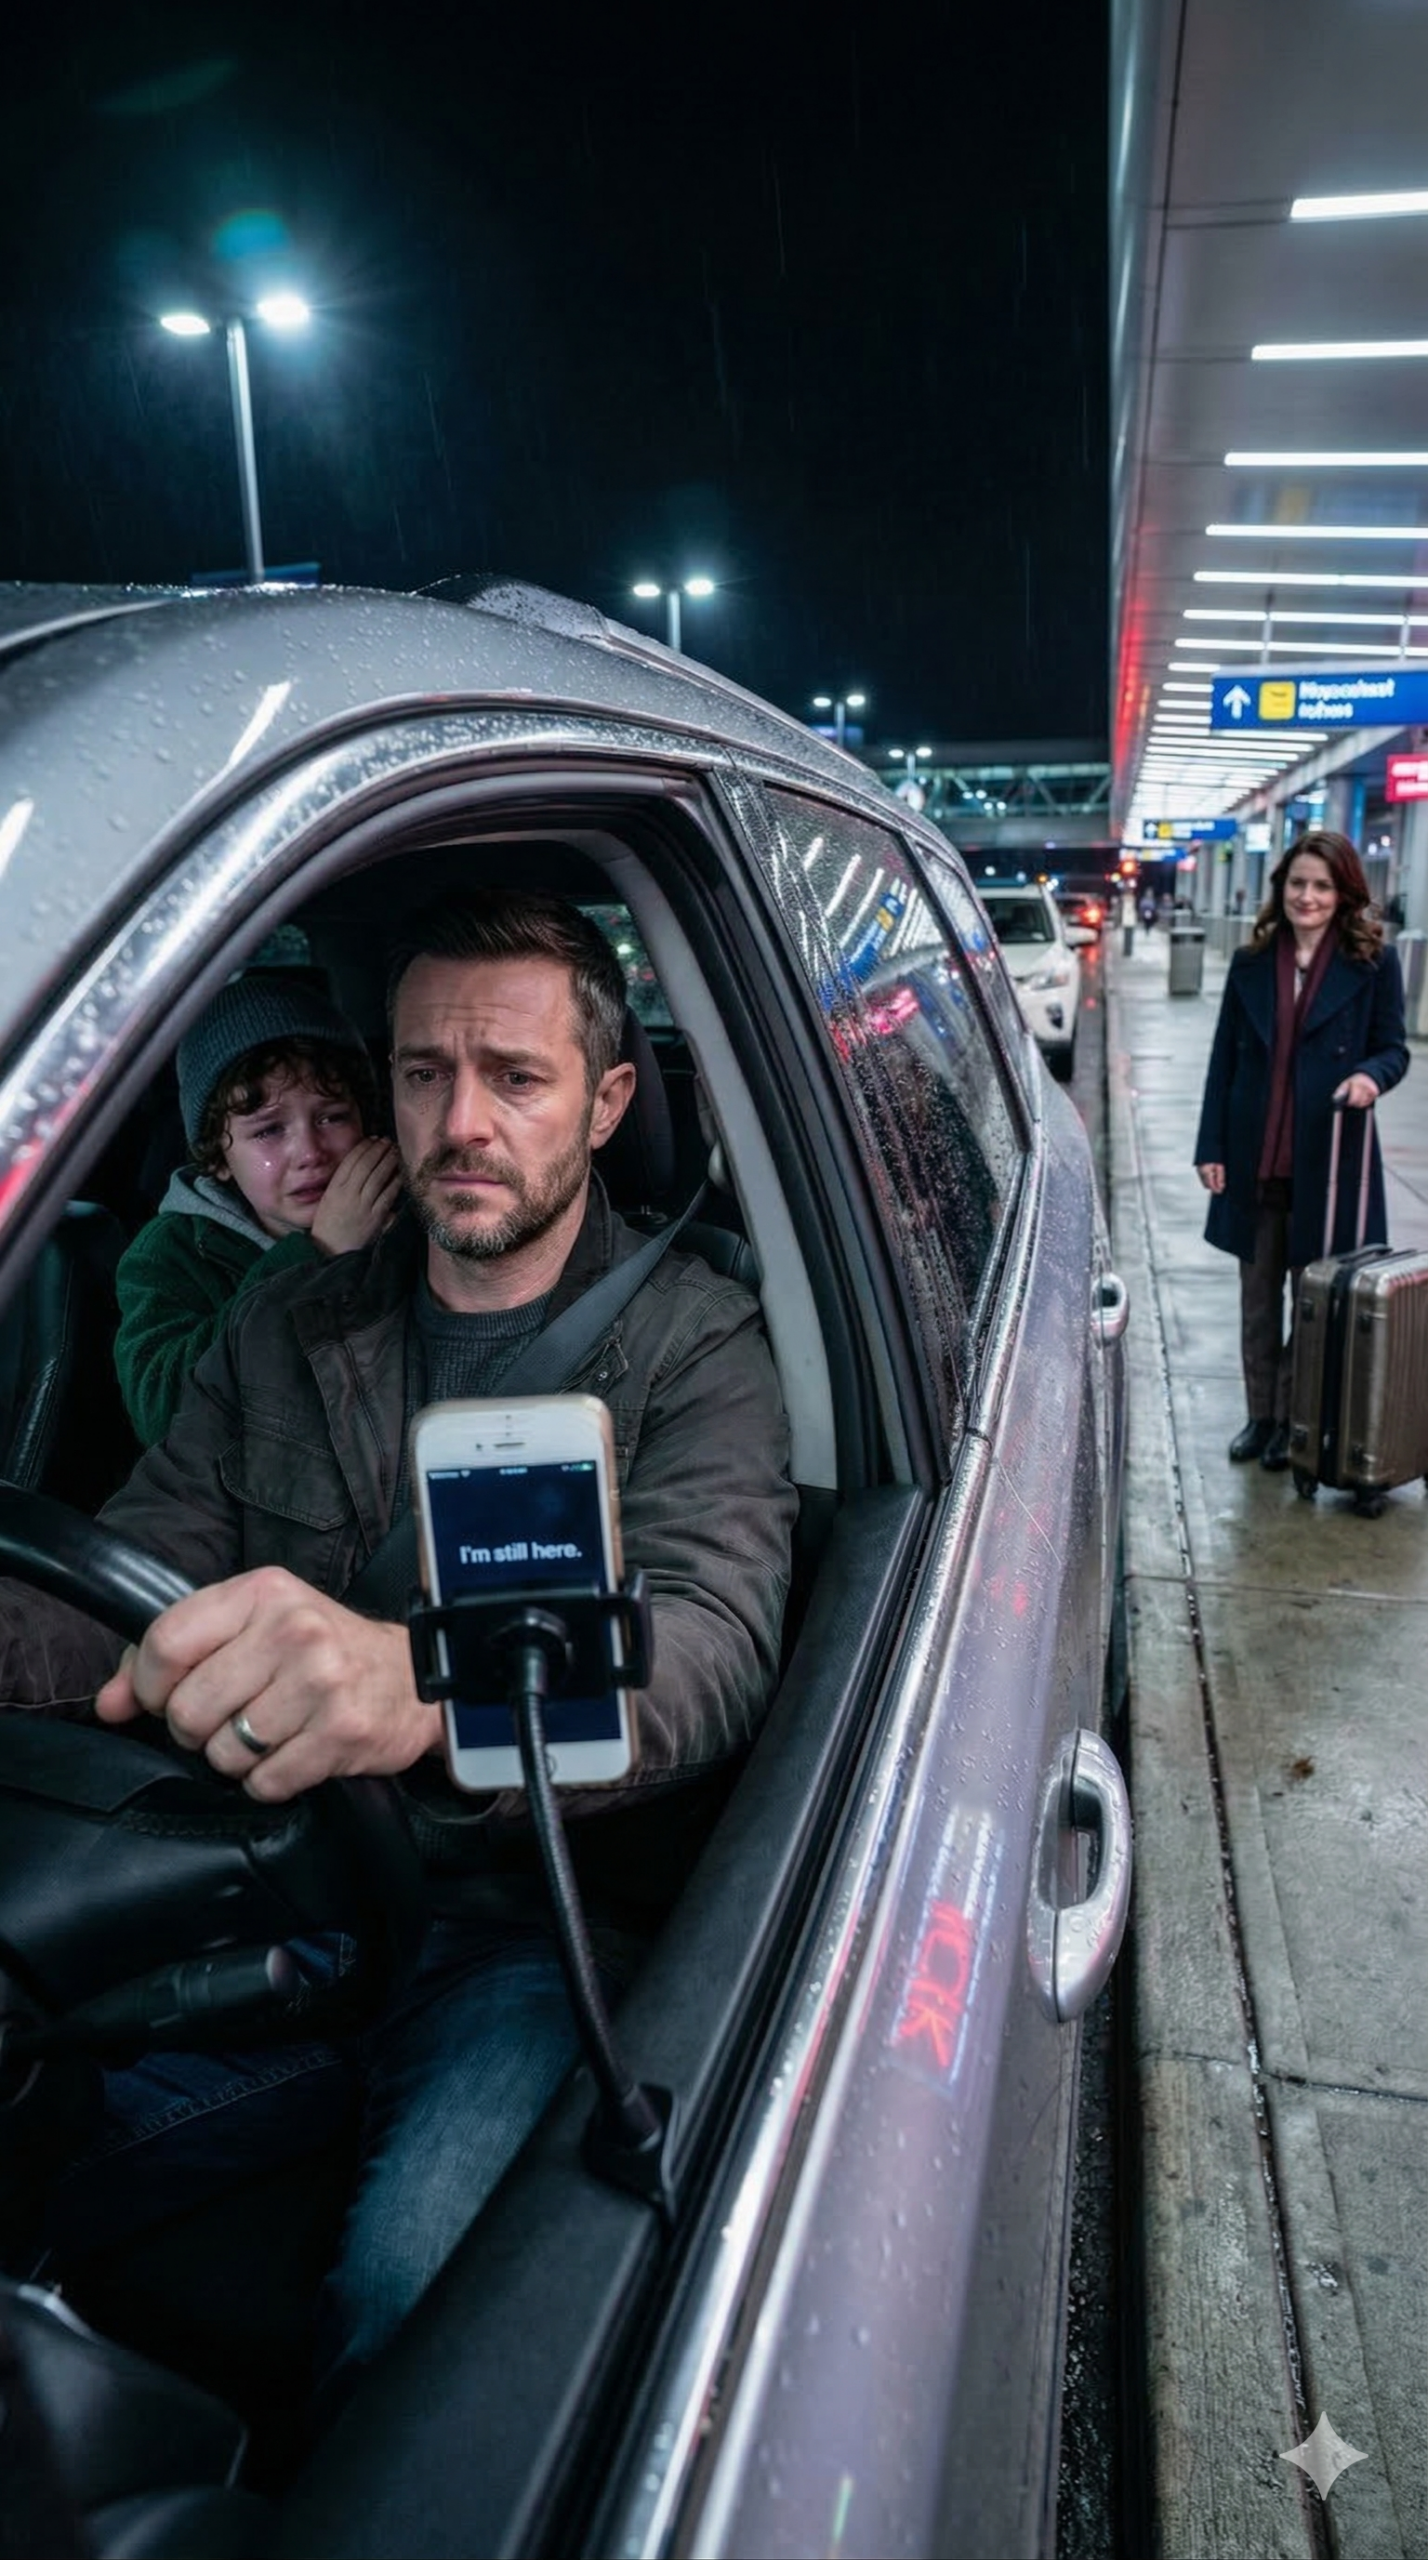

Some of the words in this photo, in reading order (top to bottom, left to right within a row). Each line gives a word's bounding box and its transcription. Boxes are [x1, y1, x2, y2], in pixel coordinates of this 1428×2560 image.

[460, 1546, 491, 1564] I'm
[493, 1542, 528, 1562] still
[531, 1541, 582, 1559] here.
